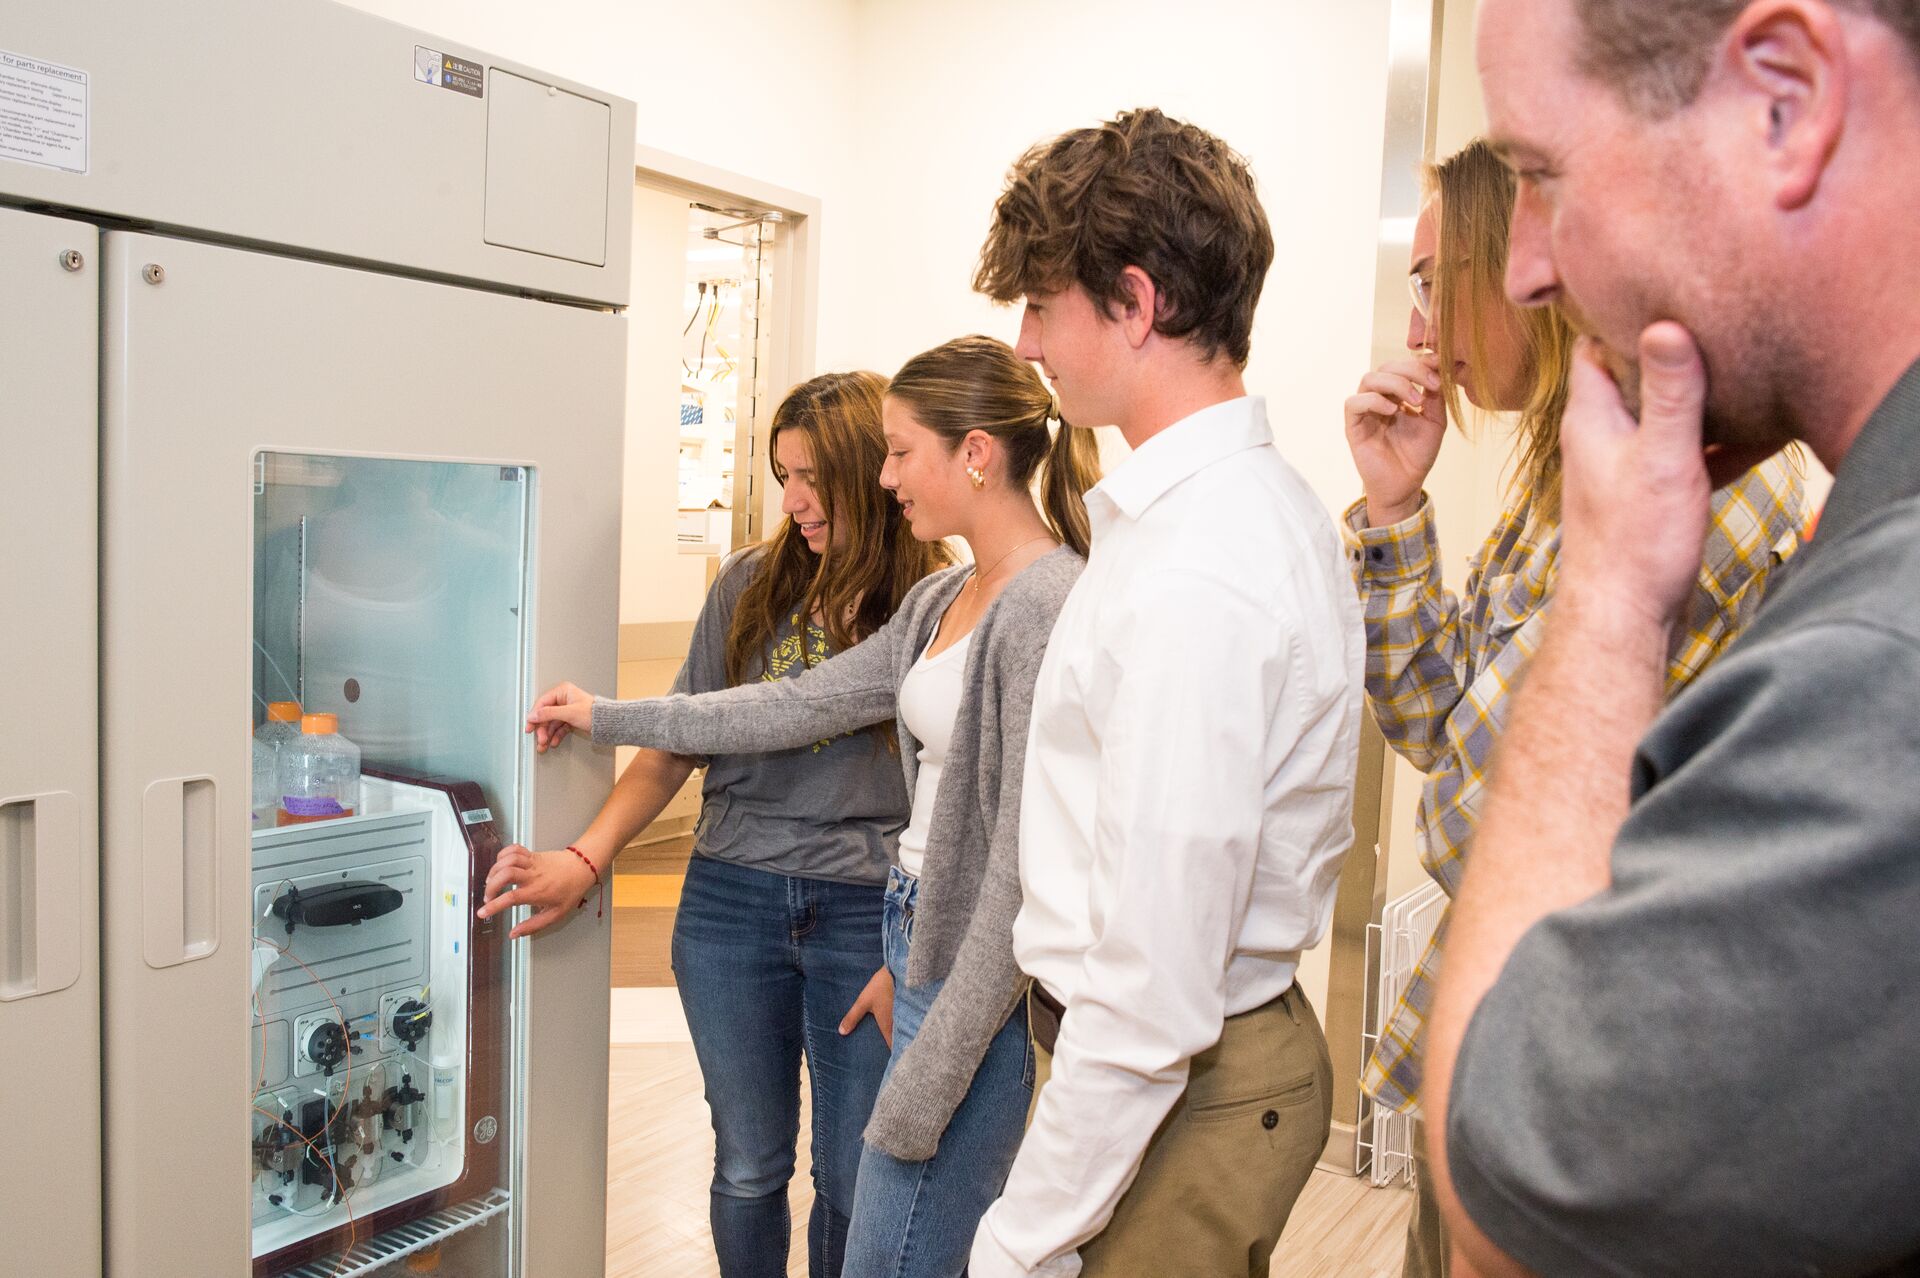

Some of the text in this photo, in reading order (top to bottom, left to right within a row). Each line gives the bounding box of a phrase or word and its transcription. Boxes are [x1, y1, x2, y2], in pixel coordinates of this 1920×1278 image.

[3, 55, 14, 64] for
[16, 60, 36, 70] parts
[37, 65, 82, 81] replacement
